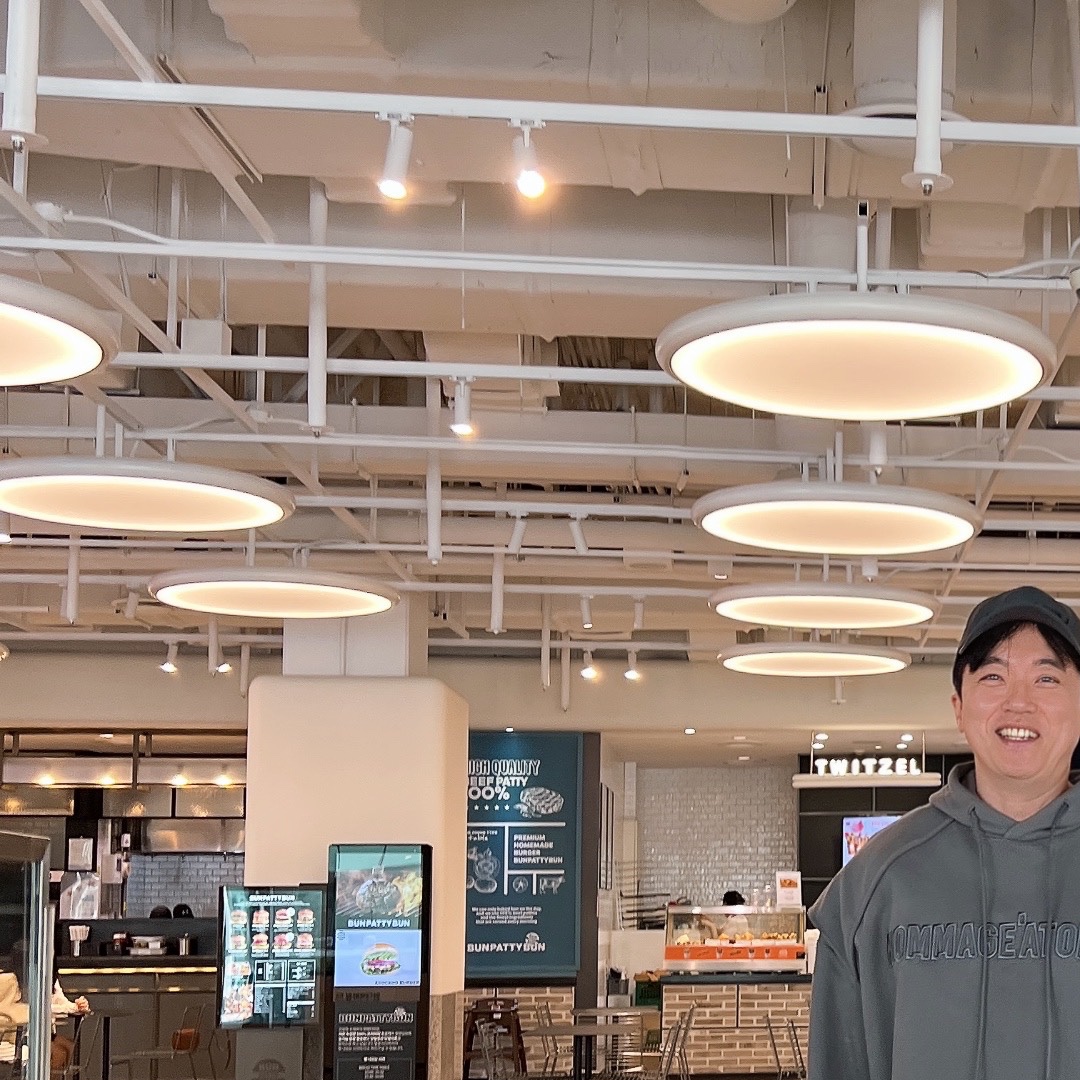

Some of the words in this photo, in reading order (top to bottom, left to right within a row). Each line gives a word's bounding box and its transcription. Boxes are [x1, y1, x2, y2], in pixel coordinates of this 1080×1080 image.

[491, 759, 541, 778] QUALITY
[814, 757, 922, 776] TWITZEL
[496, 775, 529, 788] PATTY
[468, 786, 511, 802] 00%
[513, 833, 546, 842] PREMIUM
[513, 841, 554, 849] HOMEMADE
[513, 849, 541, 857] BURGER
[513, 856, 563, 865] BUNPATTYBUN
[347, 918, 411, 928] BUNPATTYBUN
